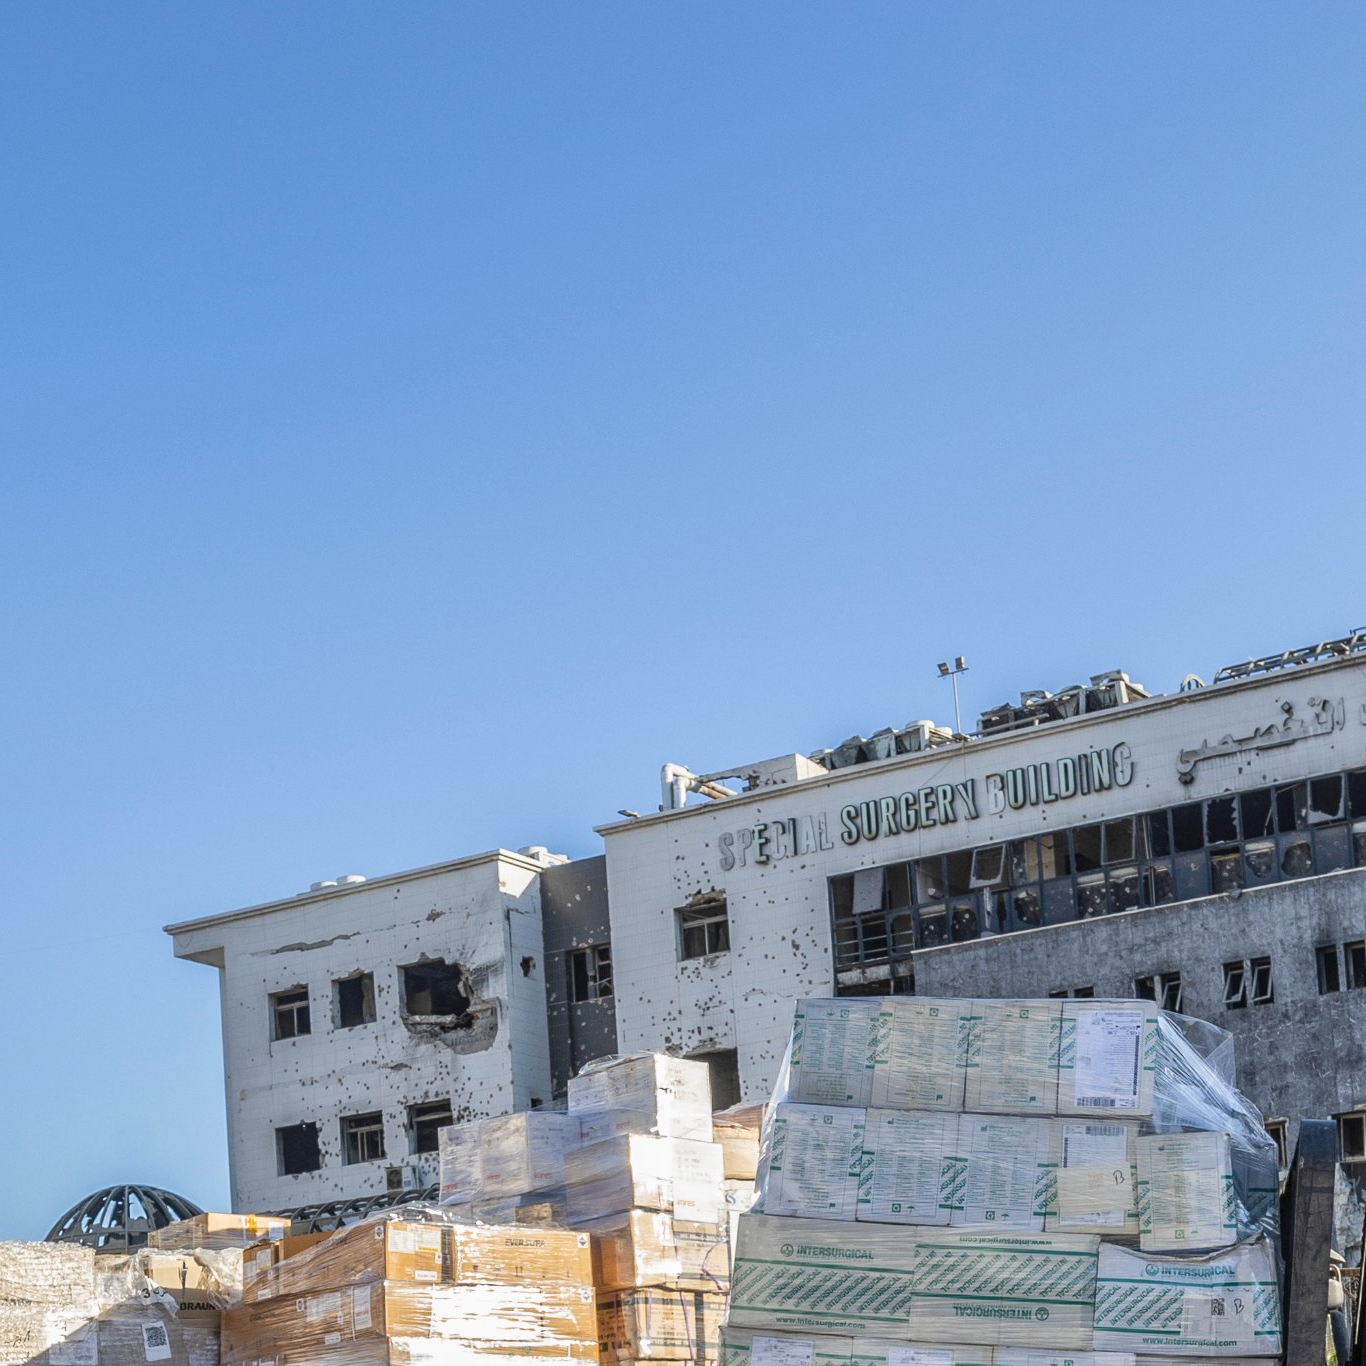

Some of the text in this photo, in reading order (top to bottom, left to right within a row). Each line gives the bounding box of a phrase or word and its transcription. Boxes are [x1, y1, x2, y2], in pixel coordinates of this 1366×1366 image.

[718, 741, 1135, 871] SPECIAL SURGERY BUILDING
[797, 1244, 874, 1260] INTERSURGICAL
[180, 1302, 216, 1311] BRAUN
[953, 1305, 1032, 1320] INTERSURGICAL
[776, 1316, 866, 1329] www.intersurgical.com
[1142, 1336, 1237, 1347] www.intersurgical.com
